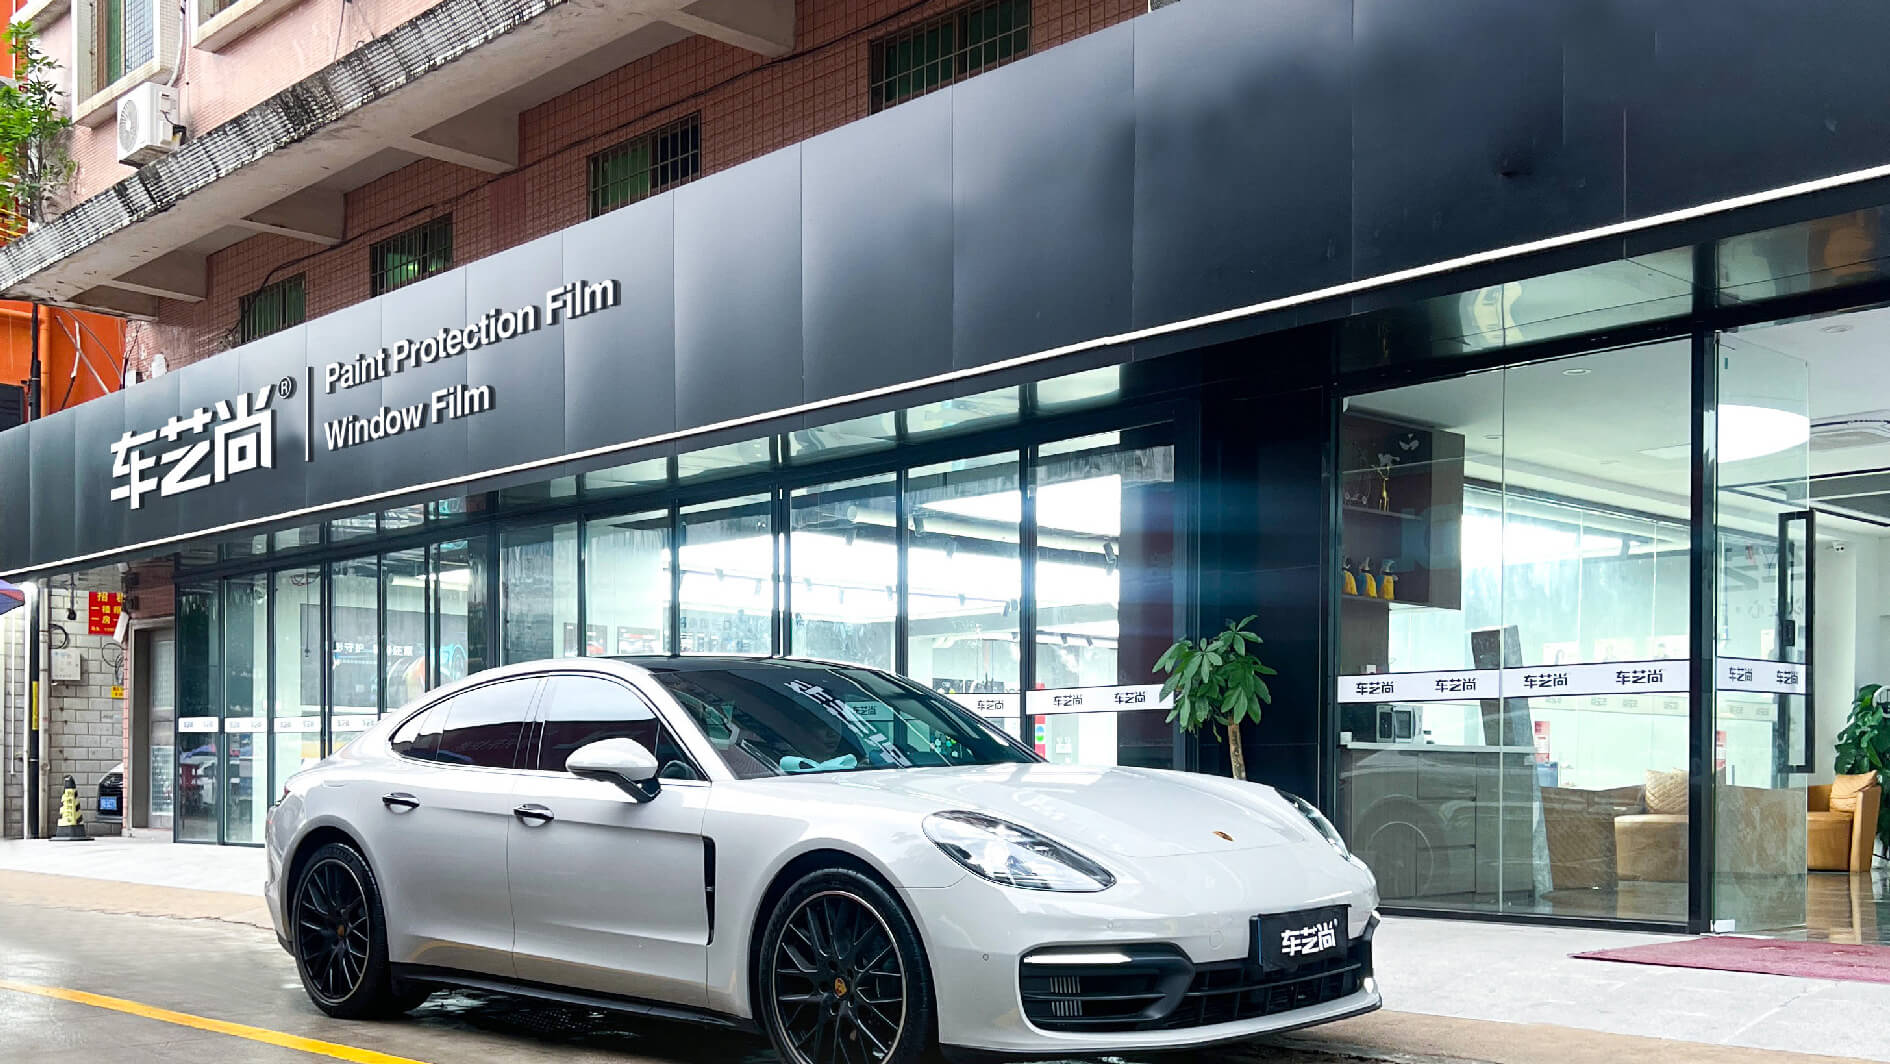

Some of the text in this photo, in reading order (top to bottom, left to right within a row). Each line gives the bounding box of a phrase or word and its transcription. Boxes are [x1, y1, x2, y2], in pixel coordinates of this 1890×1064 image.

[325, 278, 621, 394] Paint Protection Film
[324, 384, 496, 450] Window Film
[111, 384, 275, 510] 车艺尚
[1523, 672, 1568, 689] 车艺尚
[1616, 668, 1663, 685] 车艺尚
[1728, 666, 1798, 685] 车艺尚 车艺尚
[1355, 681, 1394, 696] 车艺尚
[1435, 677, 1476, 693] 车艺尚
[977, 699, 1004, 711] 车艺尚
[1053, 691, 1146, 707] 车艺尚 车艺尚
[1280, 920, 1336, 957] 车艺尚
